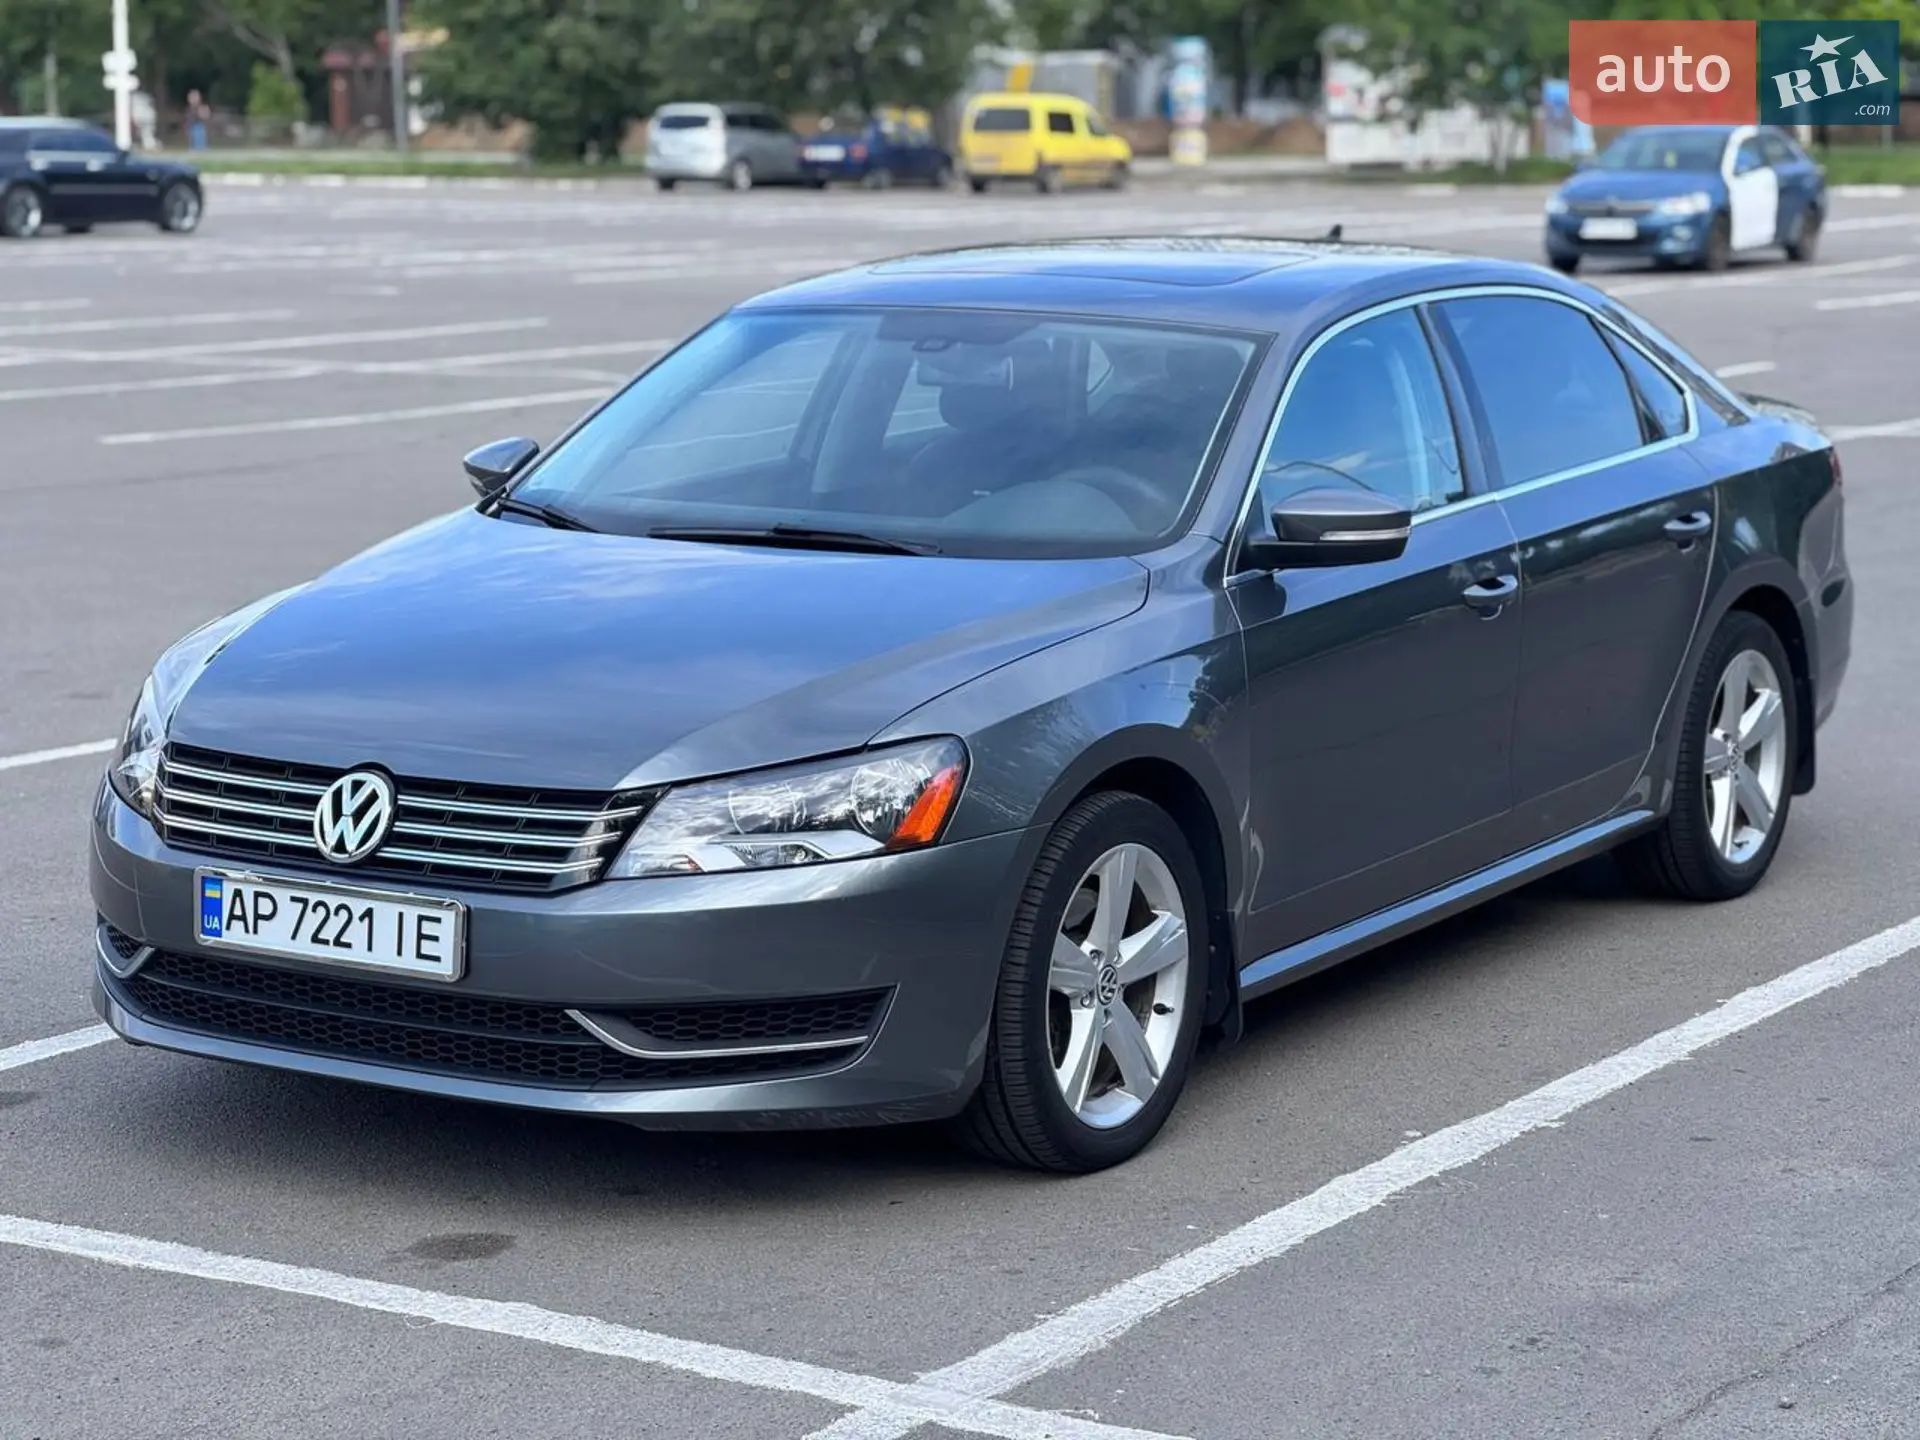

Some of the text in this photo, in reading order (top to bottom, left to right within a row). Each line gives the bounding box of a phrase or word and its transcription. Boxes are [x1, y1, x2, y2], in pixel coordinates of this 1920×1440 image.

[204, 914, 221, 931] UA
[225, 887, 442, 963] AP 7221 IE
